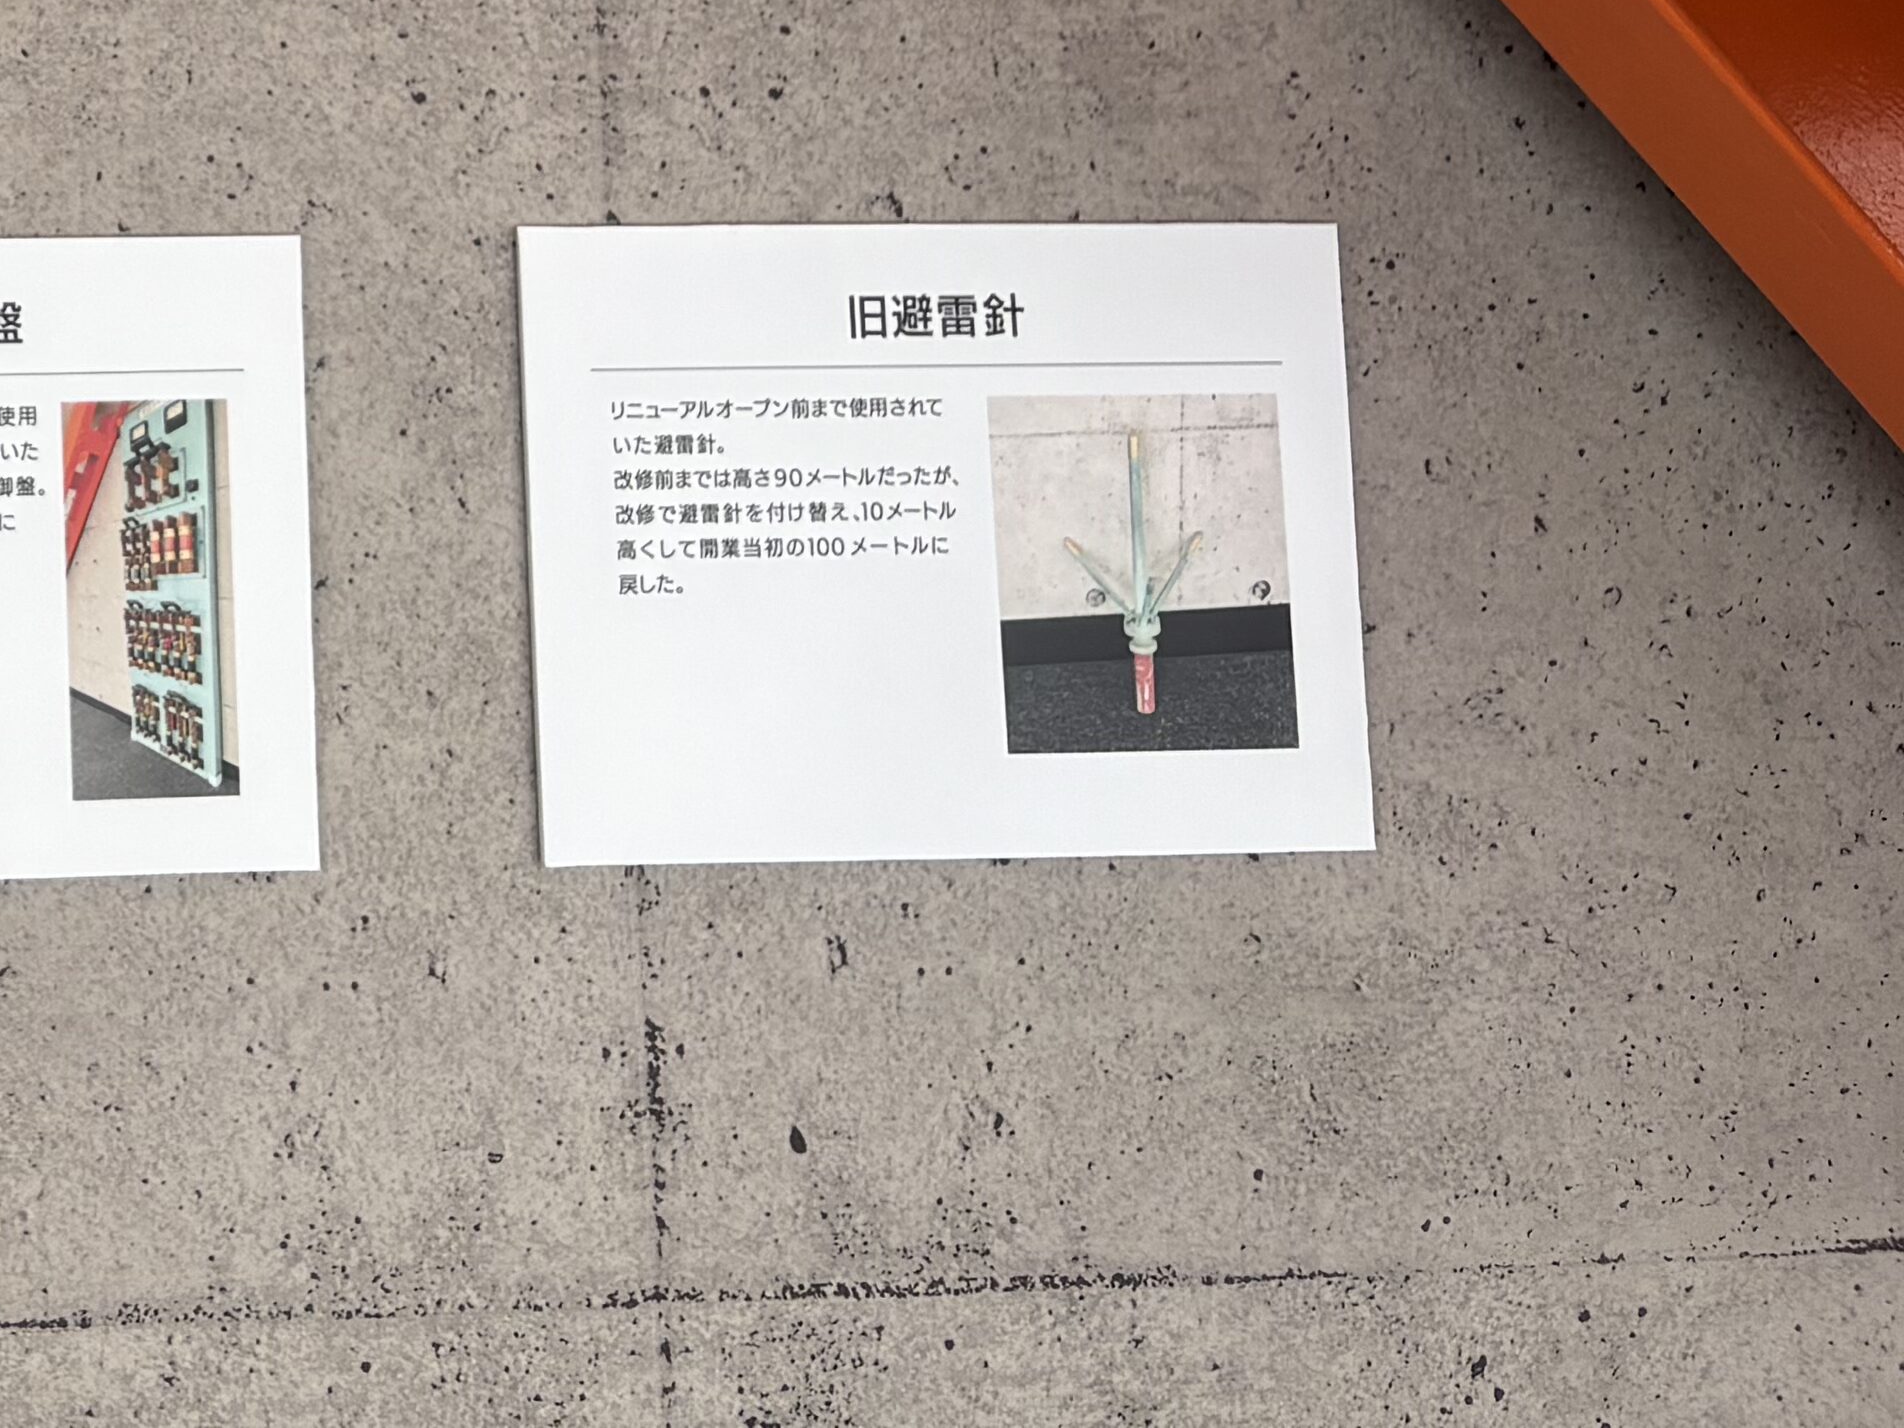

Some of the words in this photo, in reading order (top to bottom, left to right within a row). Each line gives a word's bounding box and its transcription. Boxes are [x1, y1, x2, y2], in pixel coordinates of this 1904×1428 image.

[848, 291, 1025, 340] 旧避雷針
[611, 396, 943, 421] リニューアルオープン前まで使用されて
[612, 432, 725, 456] いた避雷針。
[613, 464, 960, 491] 改修前までは高さ90メートルだったが、
[615, 500, 957, 526] 改修で避雷針を付け替え、10メートル
[616, 535, 950, 561] 高くして開業当初の100メートルに
[618, 573, 684, 596] 戻した。
